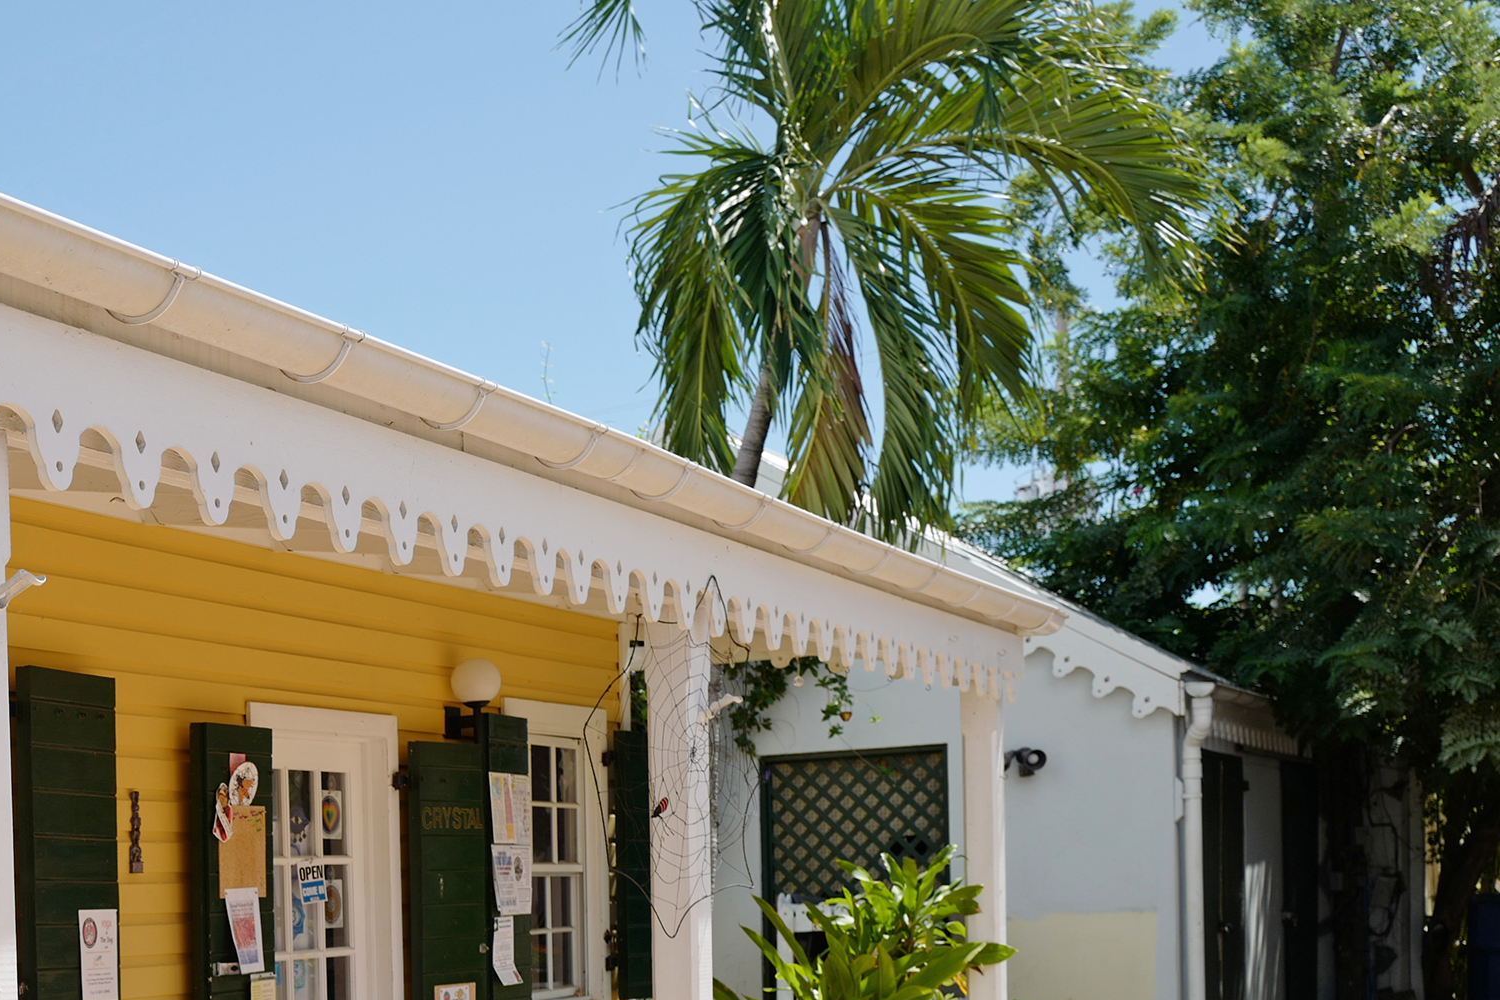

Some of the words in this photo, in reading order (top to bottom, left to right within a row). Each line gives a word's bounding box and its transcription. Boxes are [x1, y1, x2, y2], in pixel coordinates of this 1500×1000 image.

[422, 806, 483, 830] CRYSTAL
[299, 865, 323, 881] OPEN
[303, 886, 318, 897] COME
